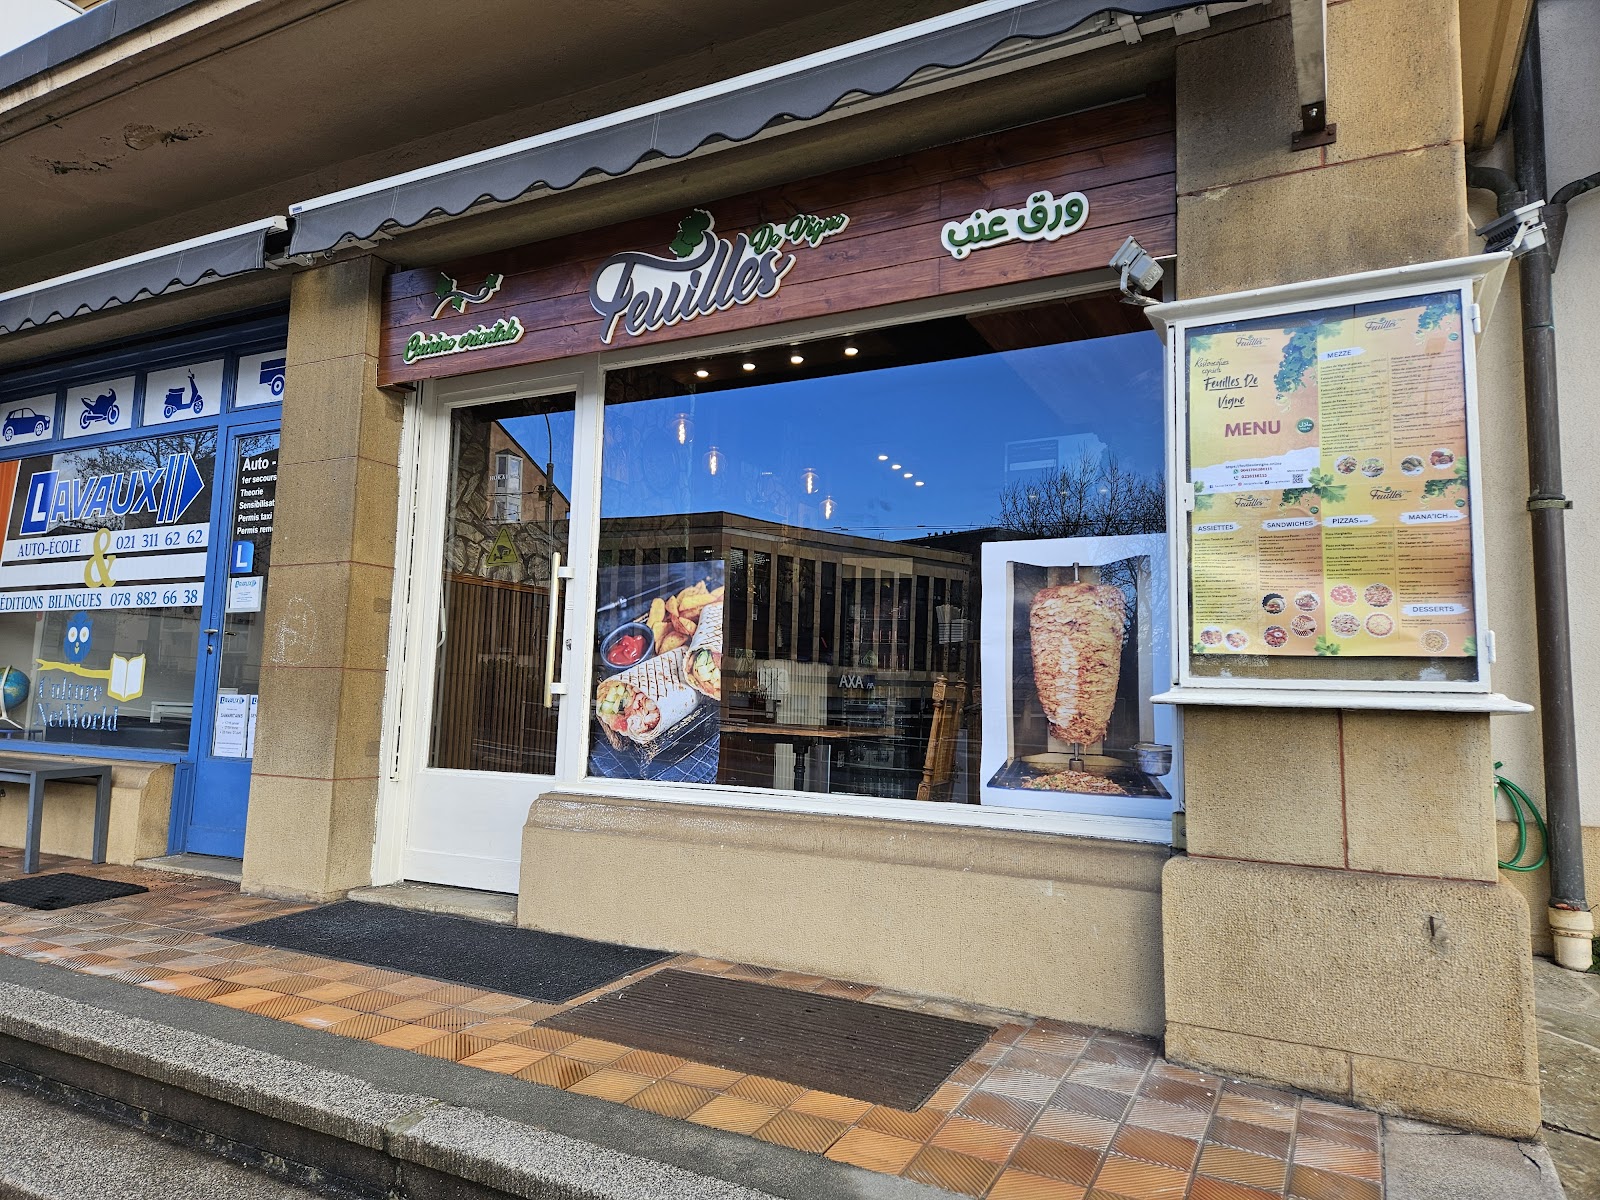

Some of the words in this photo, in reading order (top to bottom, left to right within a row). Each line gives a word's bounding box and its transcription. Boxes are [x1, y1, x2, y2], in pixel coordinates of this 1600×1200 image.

[1017, 194, 1084, 234] ورق
[749, 224, 782, 255] De
[785, 215, 845, 244] Vigne
[947, 212, 1009, 255] عنب
[589, 232, 789, 341] Feuilles
[1327, 350, 1353, 358] MEZZE
[1204, 376, 1241, 391] Feuilles
[1244, 374, 1258, 387] De
[1218, 394, 1245, 409] Vigne
[1225, 420, 1281, 437] MENU
[242, 457, 269, 471] Auto
[252, 474, 277, 483] secours
[26, 467, 165, 527] LAVAUX
[238, 513, 259, 522] Permis
[260, 512, 272, 520] taxi
[1197, 524, 1234, 532] ASSIETTES
[1266, 520, 1315, 529] SANDWICHES
[237, 526, 258, 535] Permis
[18, 538, 81, 557] AUTO-ÉCOLE
[116, 535, 135, 550] 021
[142, 533, 158, 548] 311
[165, 531, 181, 546] 62
[187, 529, 203, 544] 62
[84, 528, 117, 588] &
[236, 545, 248, 567] L
[0, 592, 43, 611] ÉDITIONS
[48, 593, 102, 609] BILINGUES
[110, 592, 131, 606] 078
[136, 591, 157, 605] 882
[162, 590, 177, 604] 66
[183, 589, 198, 604] 38
[39, 677, 102, 702] Culture
[35, 703, 118, 732] NetWorld
